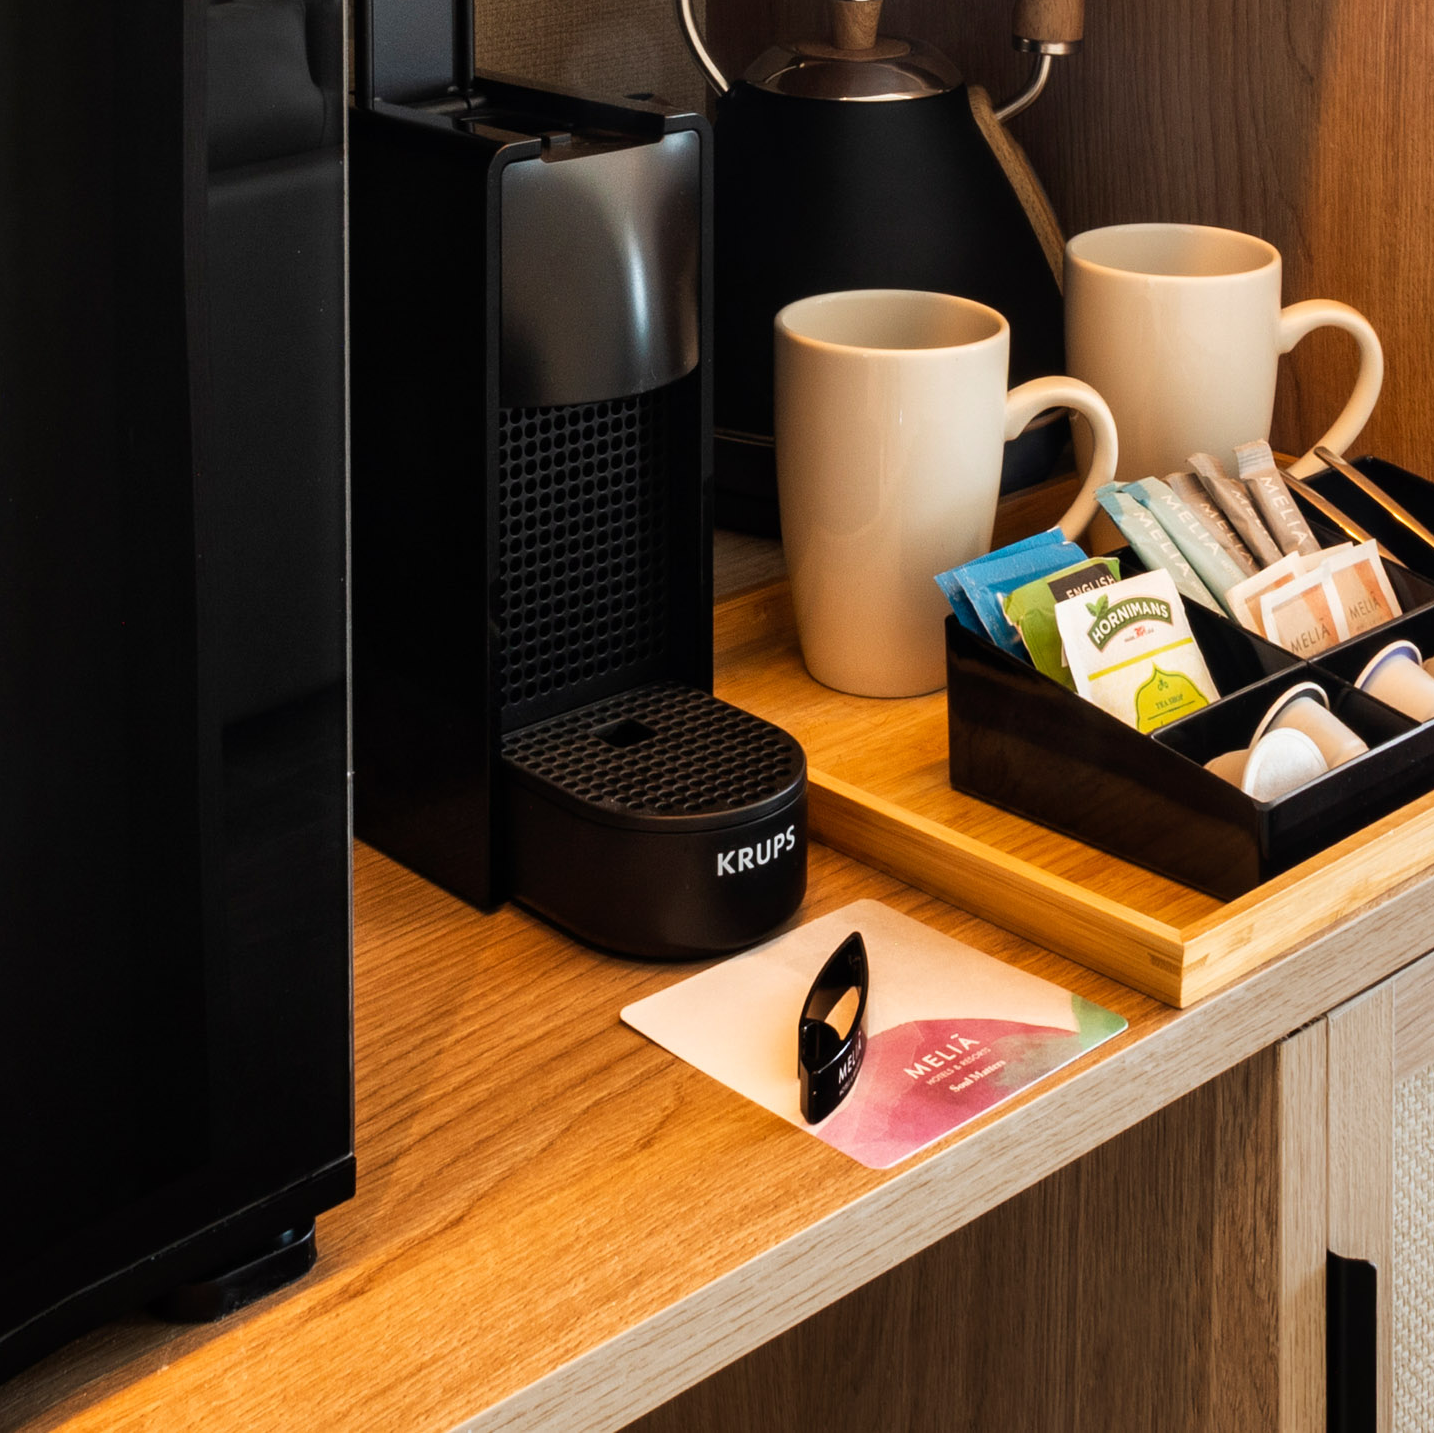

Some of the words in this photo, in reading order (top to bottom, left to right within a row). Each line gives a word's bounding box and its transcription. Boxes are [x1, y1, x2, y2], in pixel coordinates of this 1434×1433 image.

[1091, 600, 1169, 644] HORNIMANS
[717, 824, 795, 876] KRUPS
[925, 1068, 954, 1086] HOTELS
[948, 1074, 974, 1094] Soul
[969, 1058, 1007, 1083] Matters
